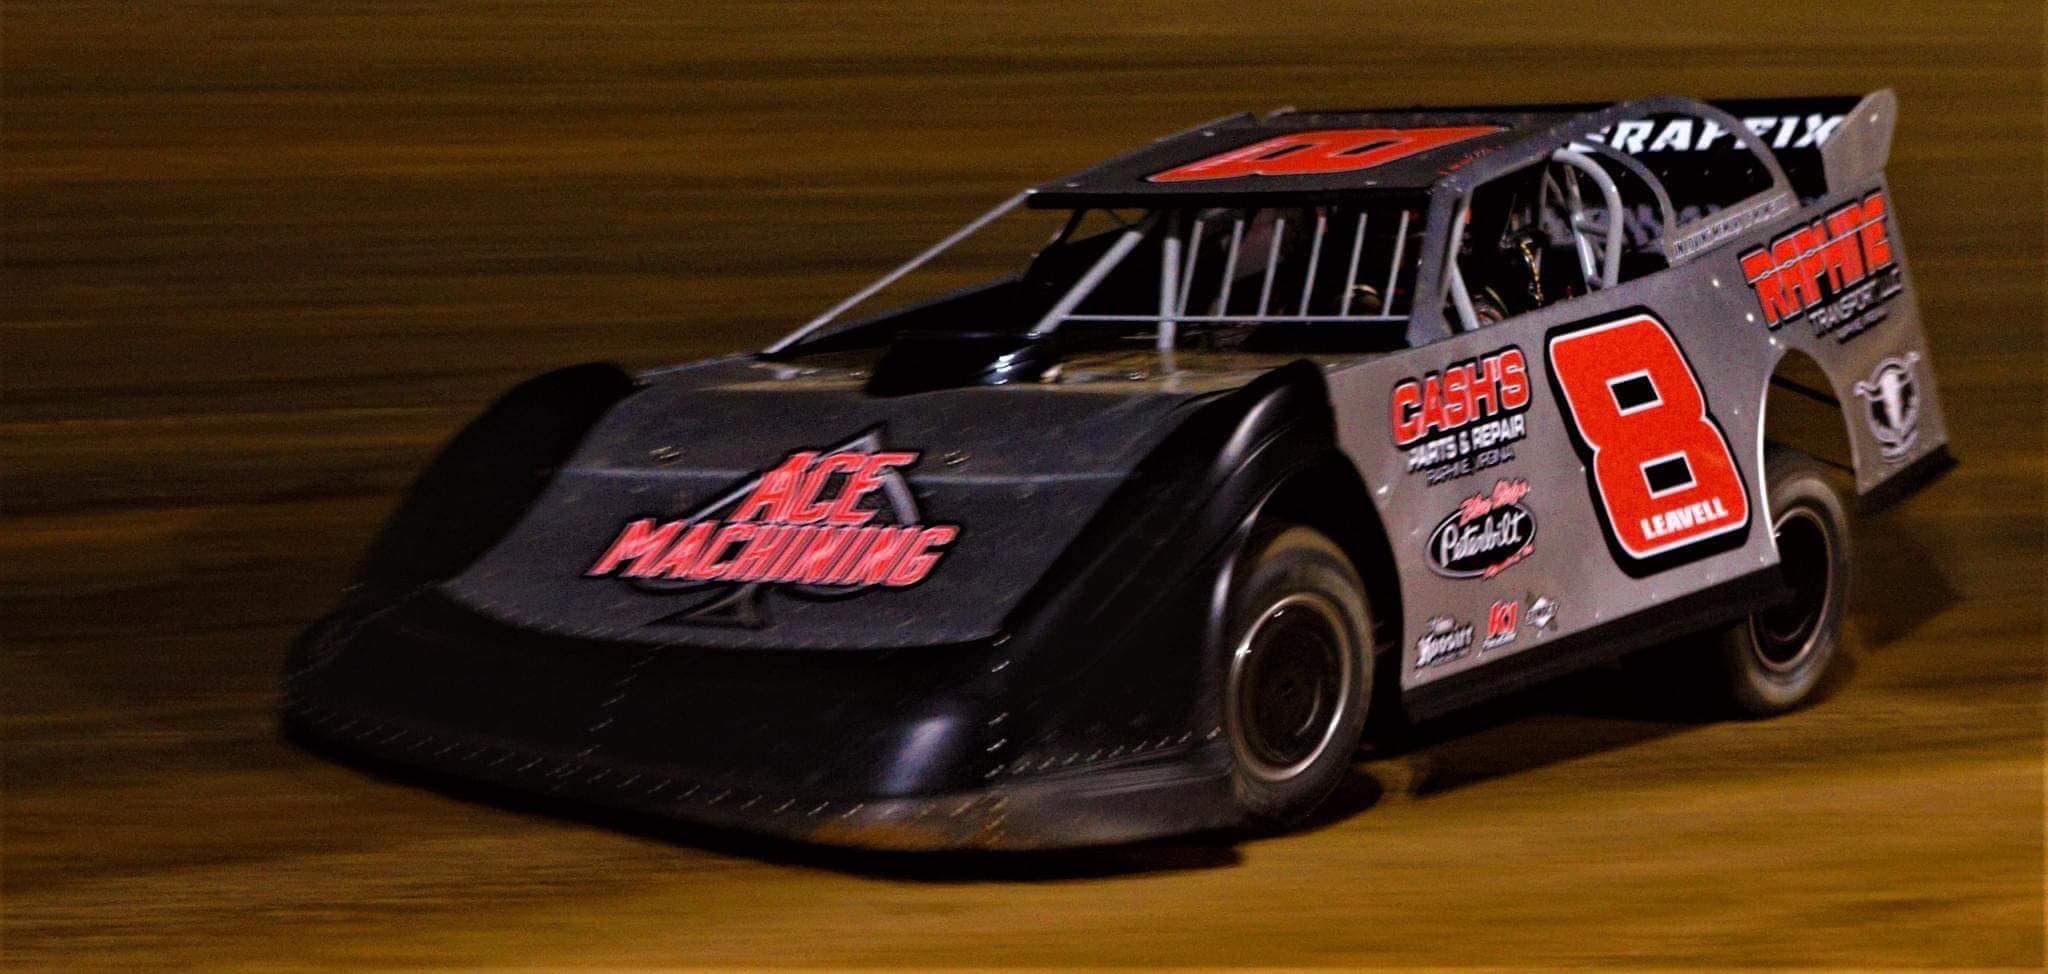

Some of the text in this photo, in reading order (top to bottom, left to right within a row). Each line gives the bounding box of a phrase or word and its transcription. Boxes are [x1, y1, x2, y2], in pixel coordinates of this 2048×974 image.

[1144, 125, 1509, 183] 8
[1740, 192, 1892, 328] RAPHINE
[1392, 349, 1530, 445] CASH'S
[1408, 413, 1526, 473] PARTS & REPAIR
[1549, 313, 1749, 560] 8
[727, 450, 920, 525] ACE
[1639, 496, 1729, 541] LEAVELL
[585, 517, 961, 588] MACHINING
[1439, 510, 1528, 568] Peterbilt
